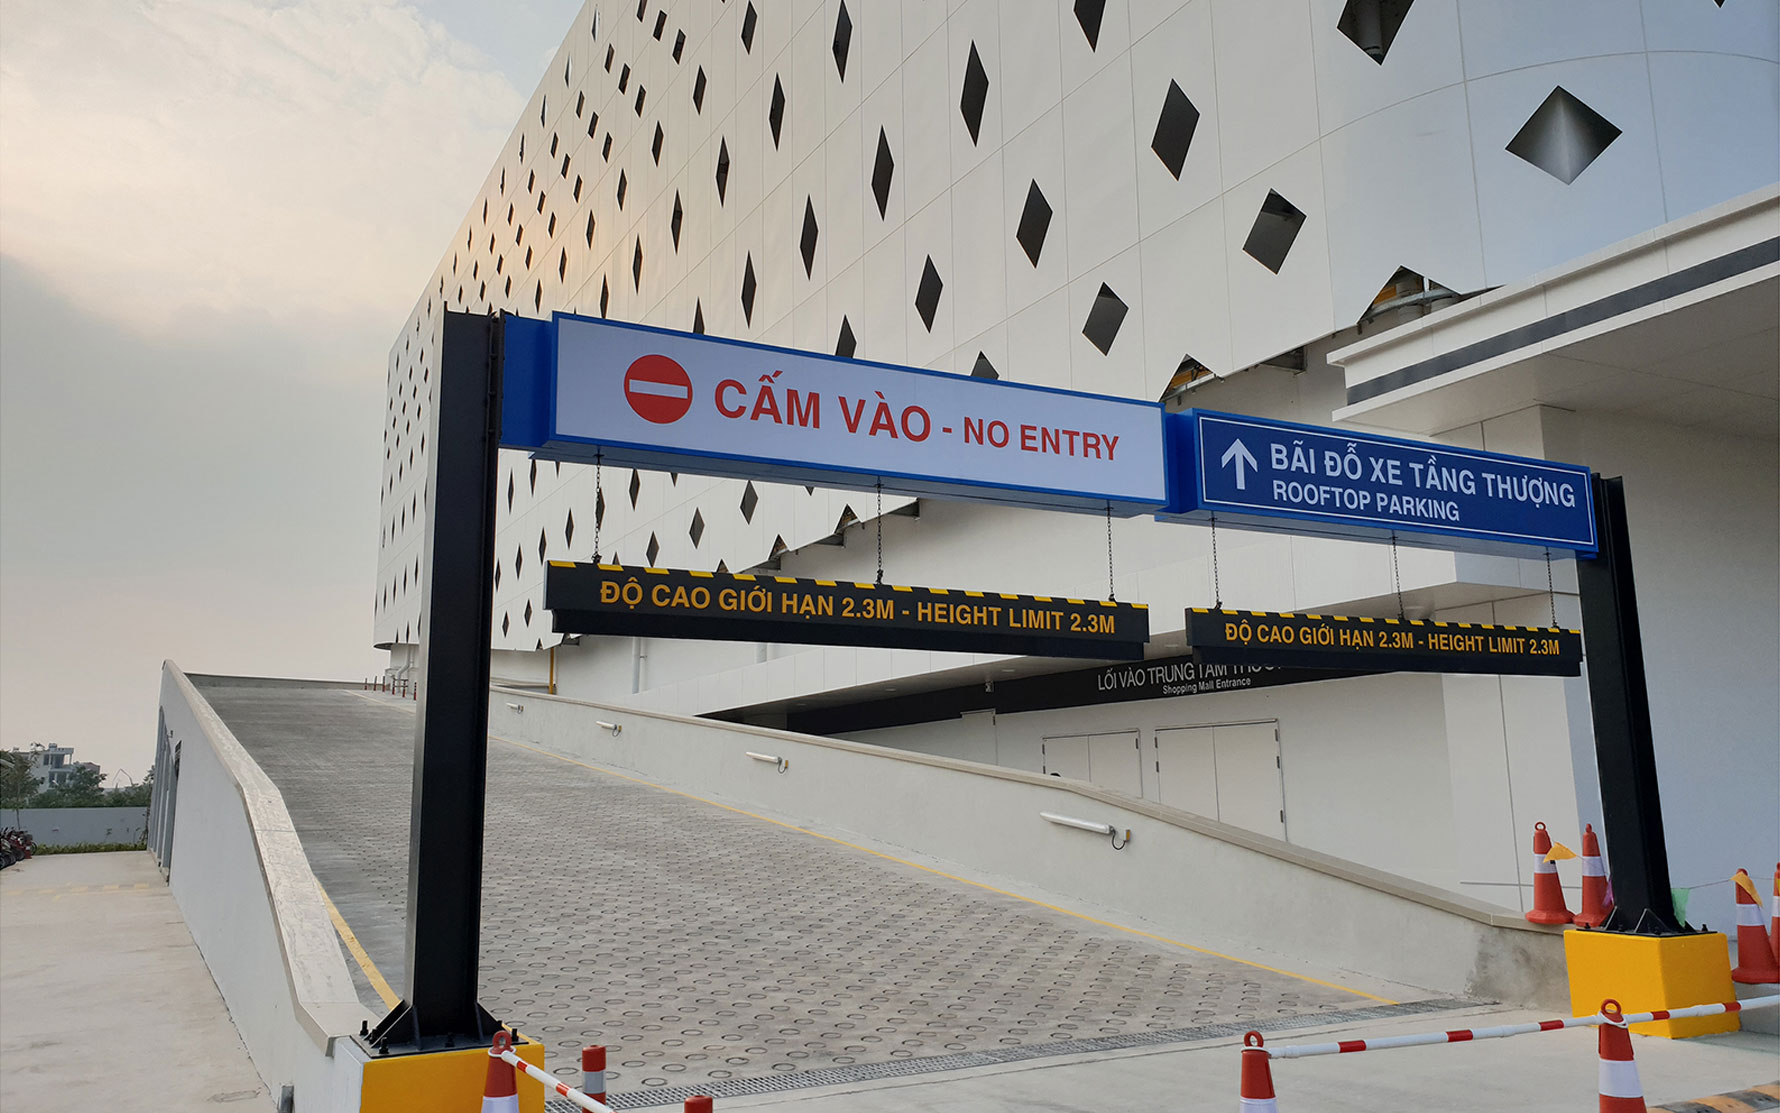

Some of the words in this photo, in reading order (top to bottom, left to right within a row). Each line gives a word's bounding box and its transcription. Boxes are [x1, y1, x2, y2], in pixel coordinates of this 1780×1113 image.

[714, 370, 820, 429] CẤM
[838, 390, 931, 442] VÀO
[964, 416, 1010, 448] NO
[1020, 424, 1119, 460] ENTRY
[1271, 440, 1316, 474] BÃI
[1324, 443, 1363, 480] ĐỖ
[1369, 457, 1403, 486] XE
[1409, 455, 1476, 495] TẦNG
[1482, 473, 1575, 508] THƯỢNG
[1273, 480, 1371, 511] ROOFTOP
[1376, 493, 1460, 521] PARKING
[600, 577, 643, 609] ĐỘ
[651, 584, 710, 609] CAO
[719, 585, 772, 613] GIỚI
[781, 593, 833, 619] HẠN
[842, 597, 894, 619] 2.3M
[917, 602, 1002, 626] HEIGHT
[1009, 608, 1064, 630] LIMIT
[1070, 613, 1115, 634] 2.3M
[1225, 619, 1252, 645] ĐỘ
[1257, 624, 1295, 644] CAO
[1300, 623, 1334, 646] GIỚI
[1340, 628, 1374, 650] HẠN
[1379, 631, 1414, 649] 2.3M
[1428, 633, 1484, 652] HEIGHT
[1489, 636, 1525, 654] LIMIT
[1529, 639, 1560, 655] 2.3M
[1098, 668, 1117, 691] LỐI
[1119, 667, 1146, 687] VÀO
[1147, 662, 1195, 684] TRUNG
[1163, 681, 1198, 695] Shopping
[1199, 681, 1214, 691] Mall
[1216, 677, 1251, 689] Entrance
